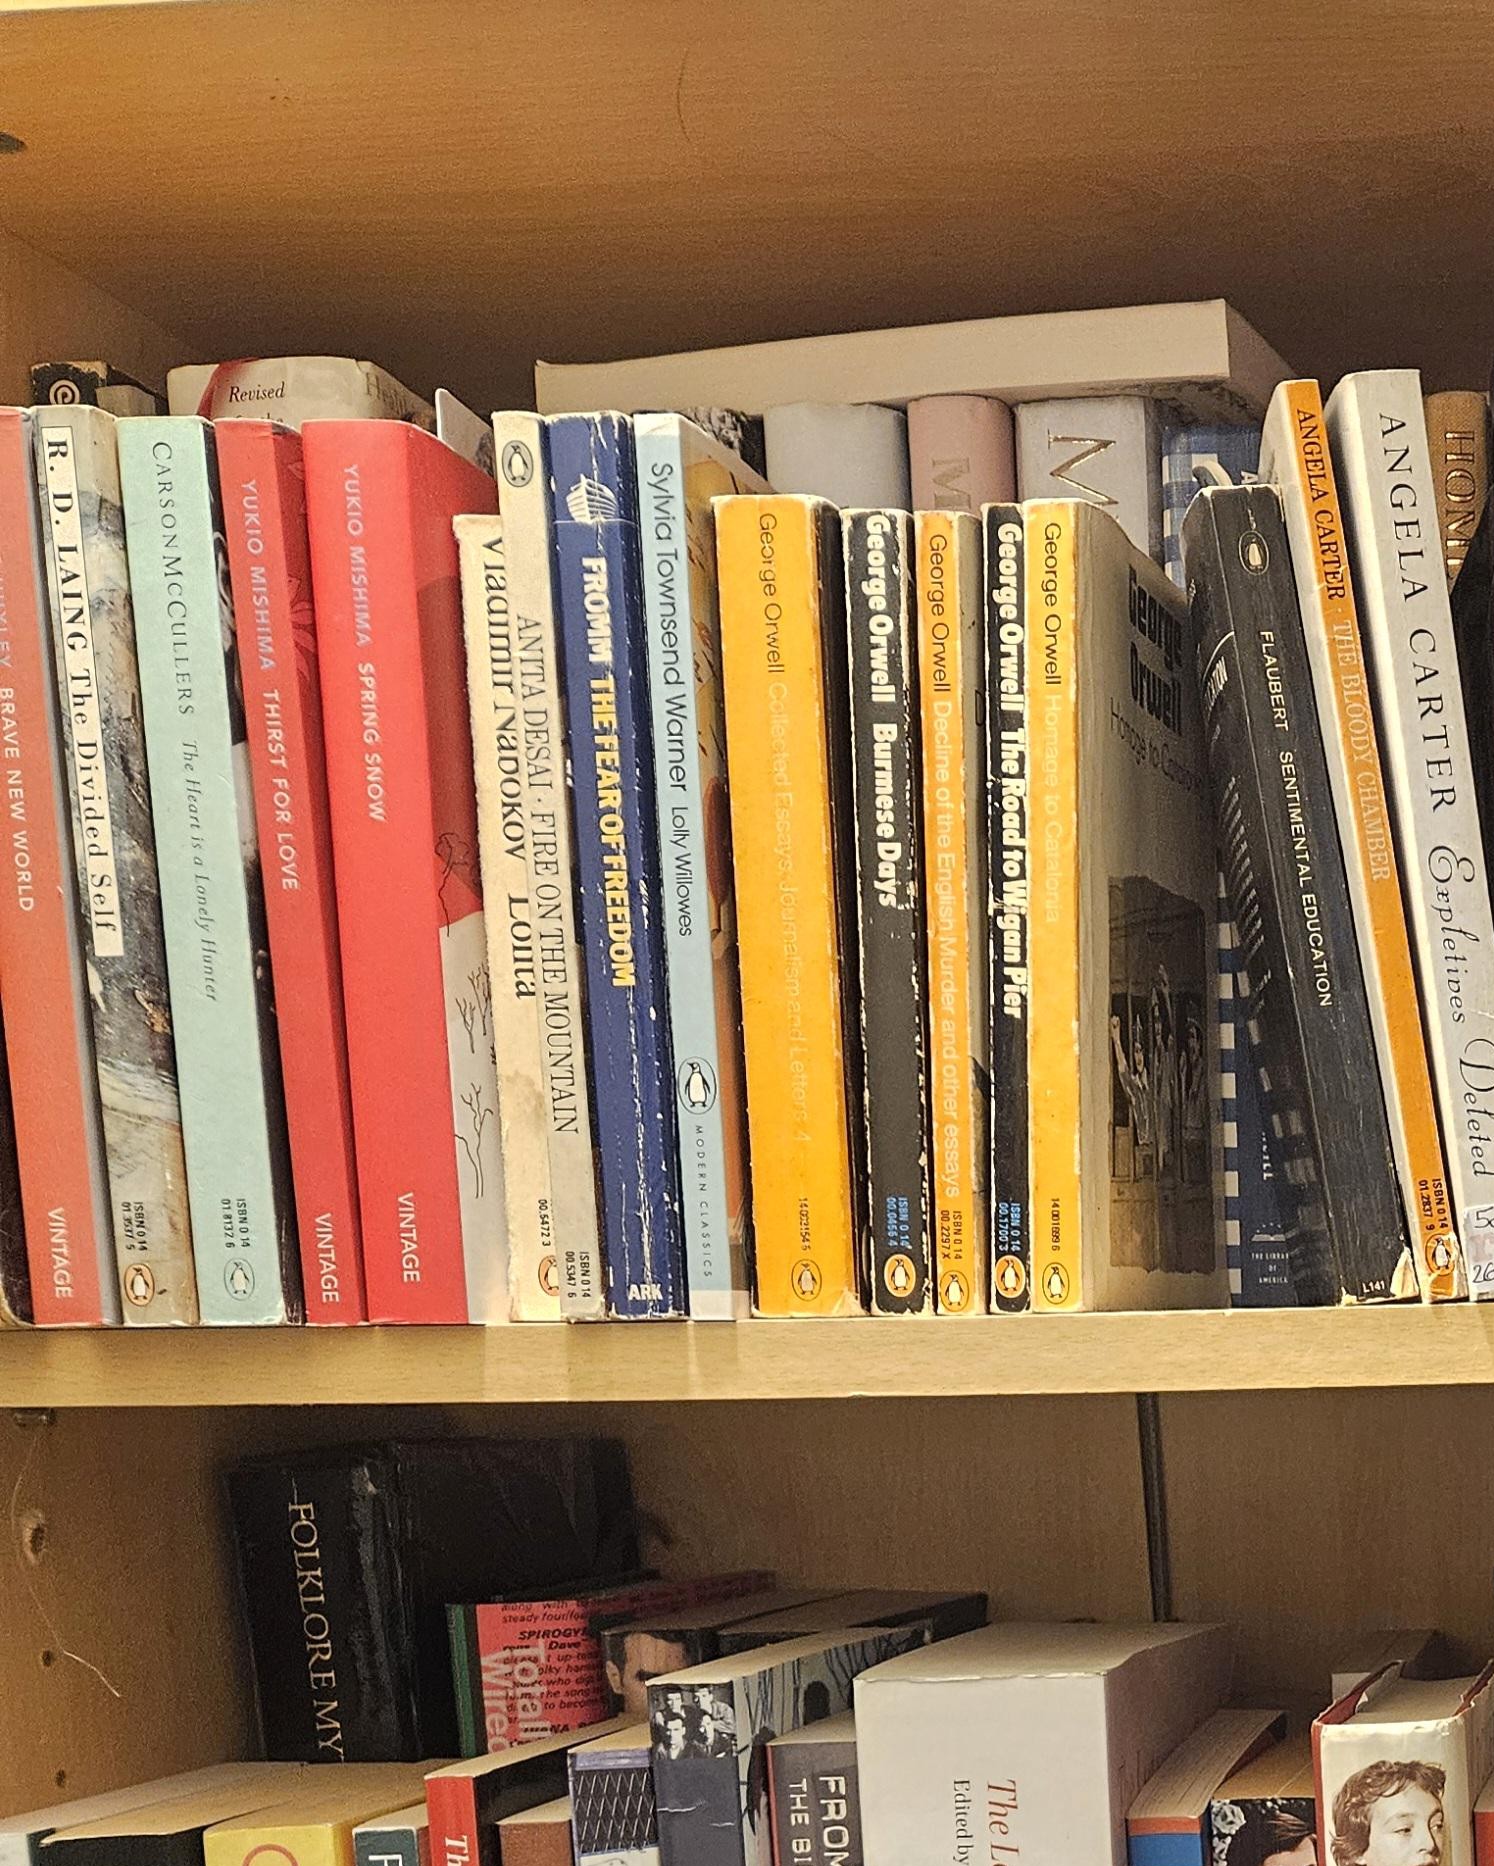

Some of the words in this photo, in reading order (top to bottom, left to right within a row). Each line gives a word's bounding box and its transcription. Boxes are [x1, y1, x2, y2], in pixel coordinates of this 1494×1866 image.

[47, 439, 68, 472] R.
[53, 493, 74, 527] D.
[342, 464, 365, 537] YUKIO
[647, 463, 673, 541] Sylvia
[1379, 412, 1430, 603] ANGELA
[57, 544, 89, 652] LAING
[350, 546, 373, 648] MISHIMA
[862, 513, 889, 613] George
[653, 547, 683, 686] Townsend
[870, 615, 898, 703] Orwell
[70, 668, 92, 725] The
[357, 661, 381, 745] SPRING
[1409, 628, 1458, 813] CARTER
[663, 693, 689, 793] Warner
[871, 722, 898, 840] Burmese
[77, 739, 109, 860] Divided
[365, 753, 388, 825] SNOW
[669, 806, 690, 851] Lolly
[1259, 631, 1290, 732] FLAUBERT
[1279, 751, 1314, 888] SENTIMENTAL
[1301, 893, 1333, 1007] EDUCATION
[89, 874, 118, 932] Self
[669, 852, 692, 937] Willowes
[873, 842, 903, 907] Days
[1427, 845, 1480, 1025] Expletives
[396, 1191, 421, 1284] VINTAGE
[628, 1283, 663, 1301] ARK
[289, 1500, 337, 1689] FOLKLORE
[986, 1777, 1018, 1837] The
